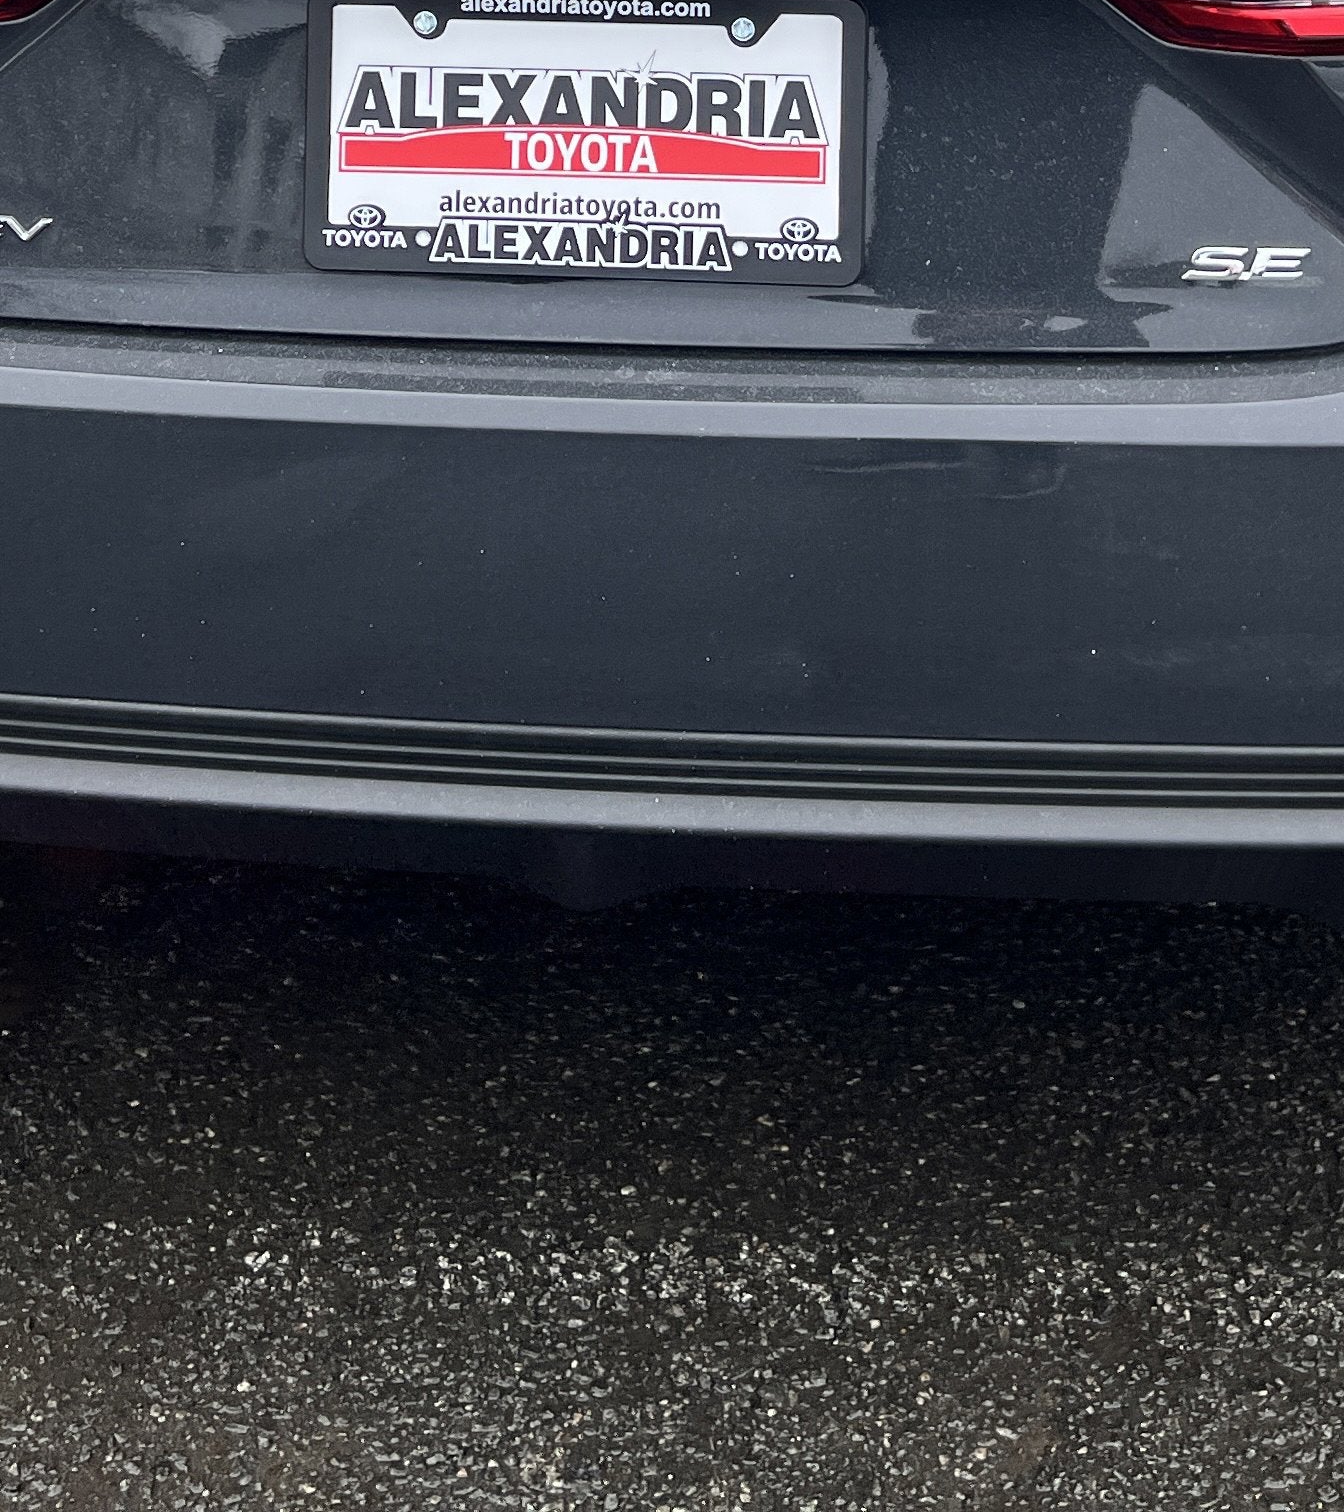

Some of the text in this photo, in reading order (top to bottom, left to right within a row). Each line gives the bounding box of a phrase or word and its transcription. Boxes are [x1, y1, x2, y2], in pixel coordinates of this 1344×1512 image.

[344, 70, 821, 141] ALEXANDRIA
[504, 131, 658, 174] TOYOTA
[439, 189, 722, 221] alexandriatoyota.com
[322, 228, 408, 250] TOYOTA
[433, 221, 730, 268] ALEXANDRIA
[755, 241, 843, 264] TOYOTA
[1180, 245, 1312, 281] SE
